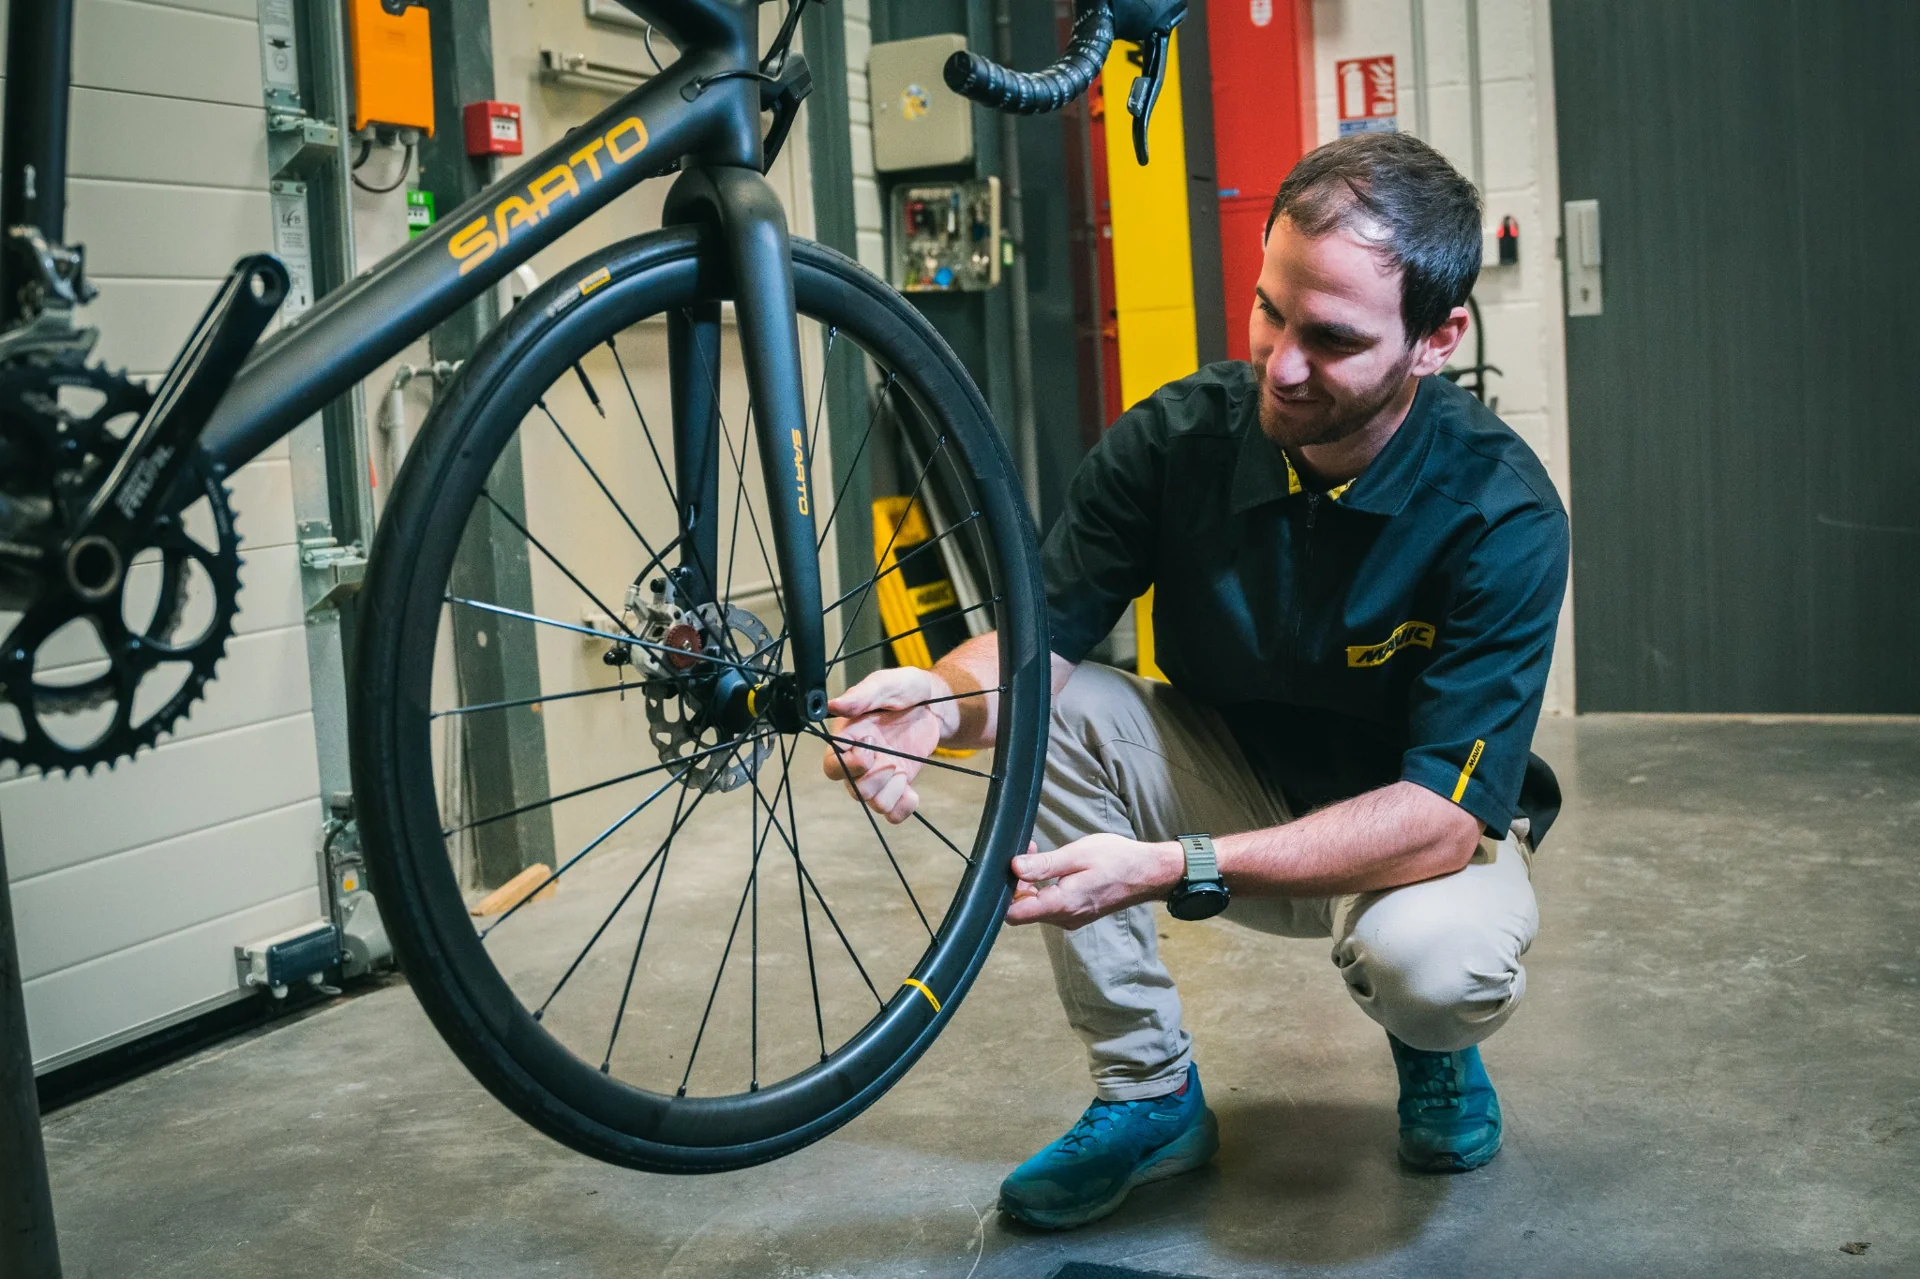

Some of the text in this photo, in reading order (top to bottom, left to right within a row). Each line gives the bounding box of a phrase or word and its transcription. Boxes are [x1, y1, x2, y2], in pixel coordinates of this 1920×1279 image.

[448, 117, 649, 276] SARTO
[791, 428, 808, 516] SARTO
[1355, 626, 1430, 663] MAVIC
[1468, 742, 1483, 769] MAVIC
